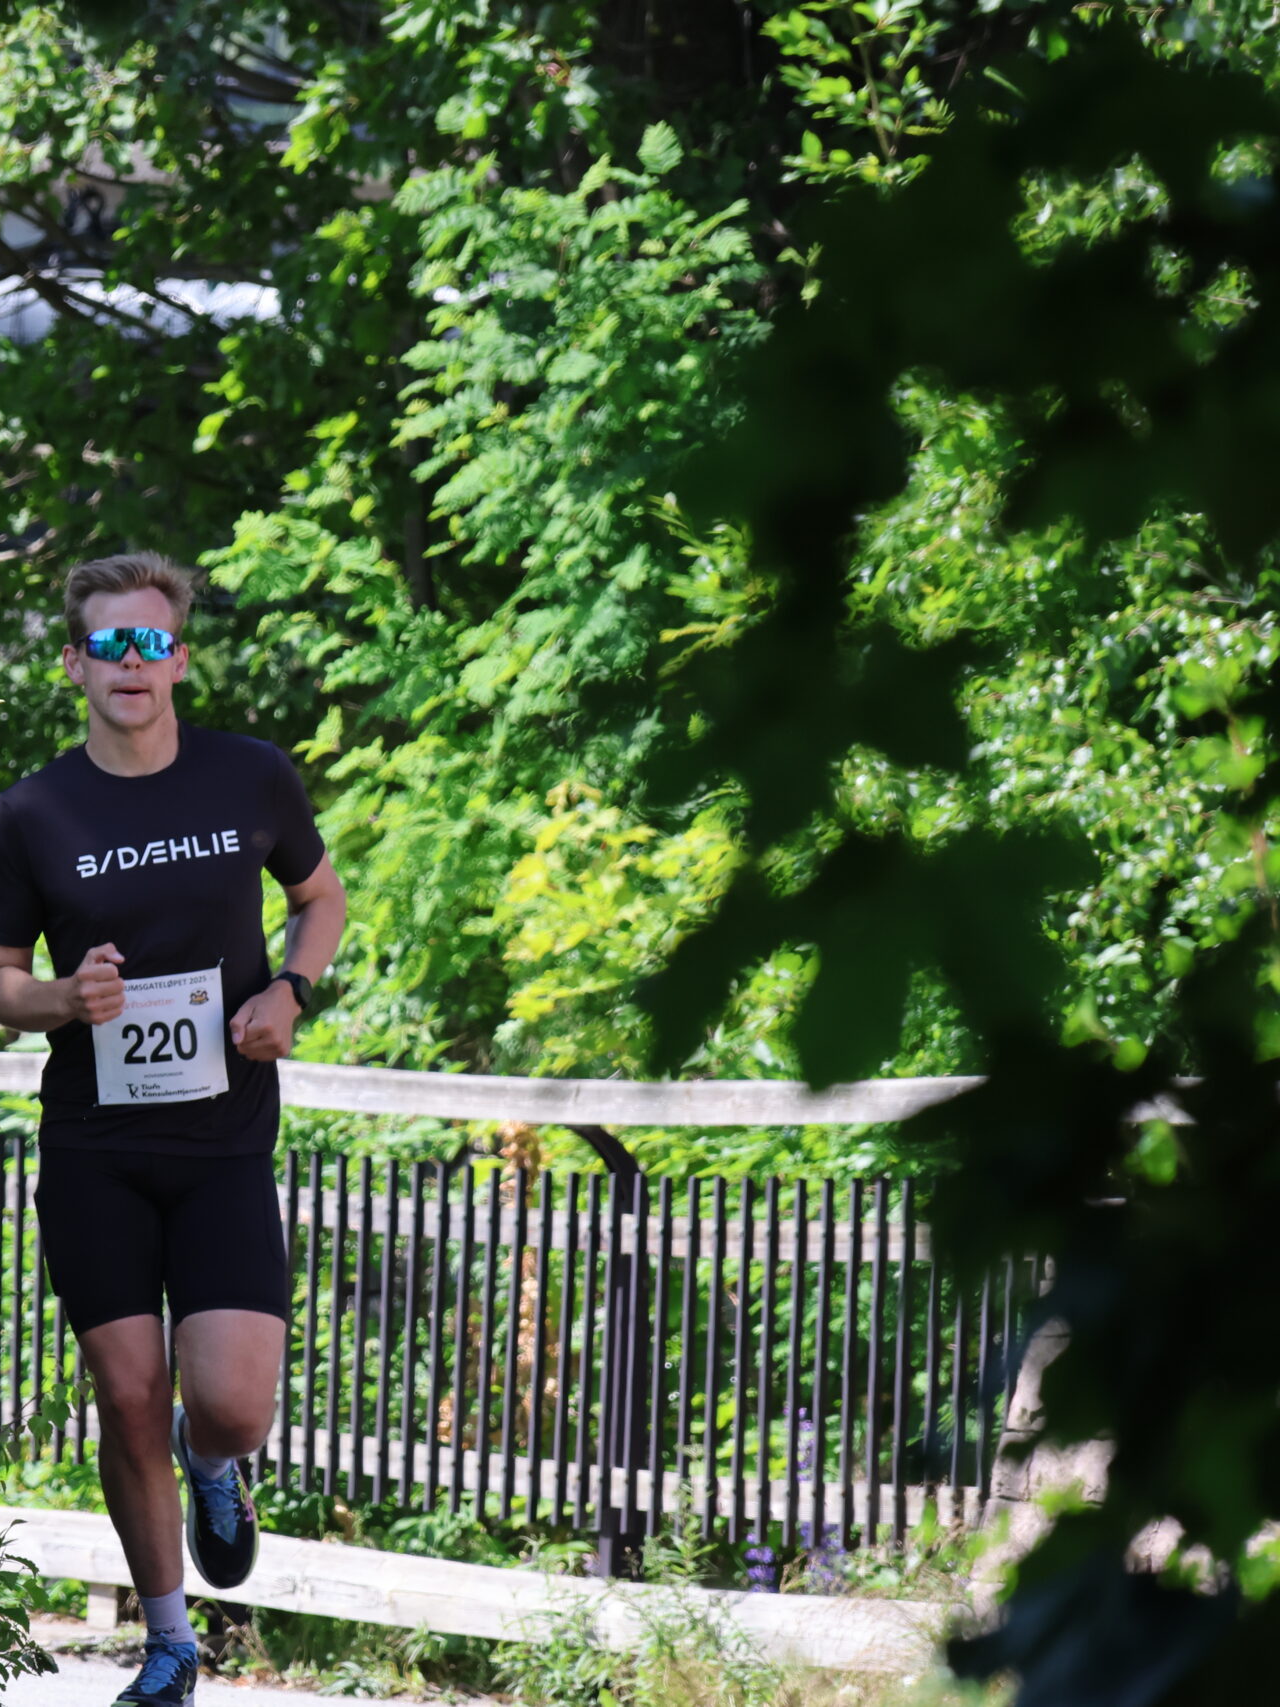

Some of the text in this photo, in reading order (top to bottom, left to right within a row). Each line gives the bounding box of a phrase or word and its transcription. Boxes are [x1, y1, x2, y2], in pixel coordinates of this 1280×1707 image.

[124, 975, 207, 992] UMSGATELØPET 2025
[121, 1018, 198, 1065] 220
